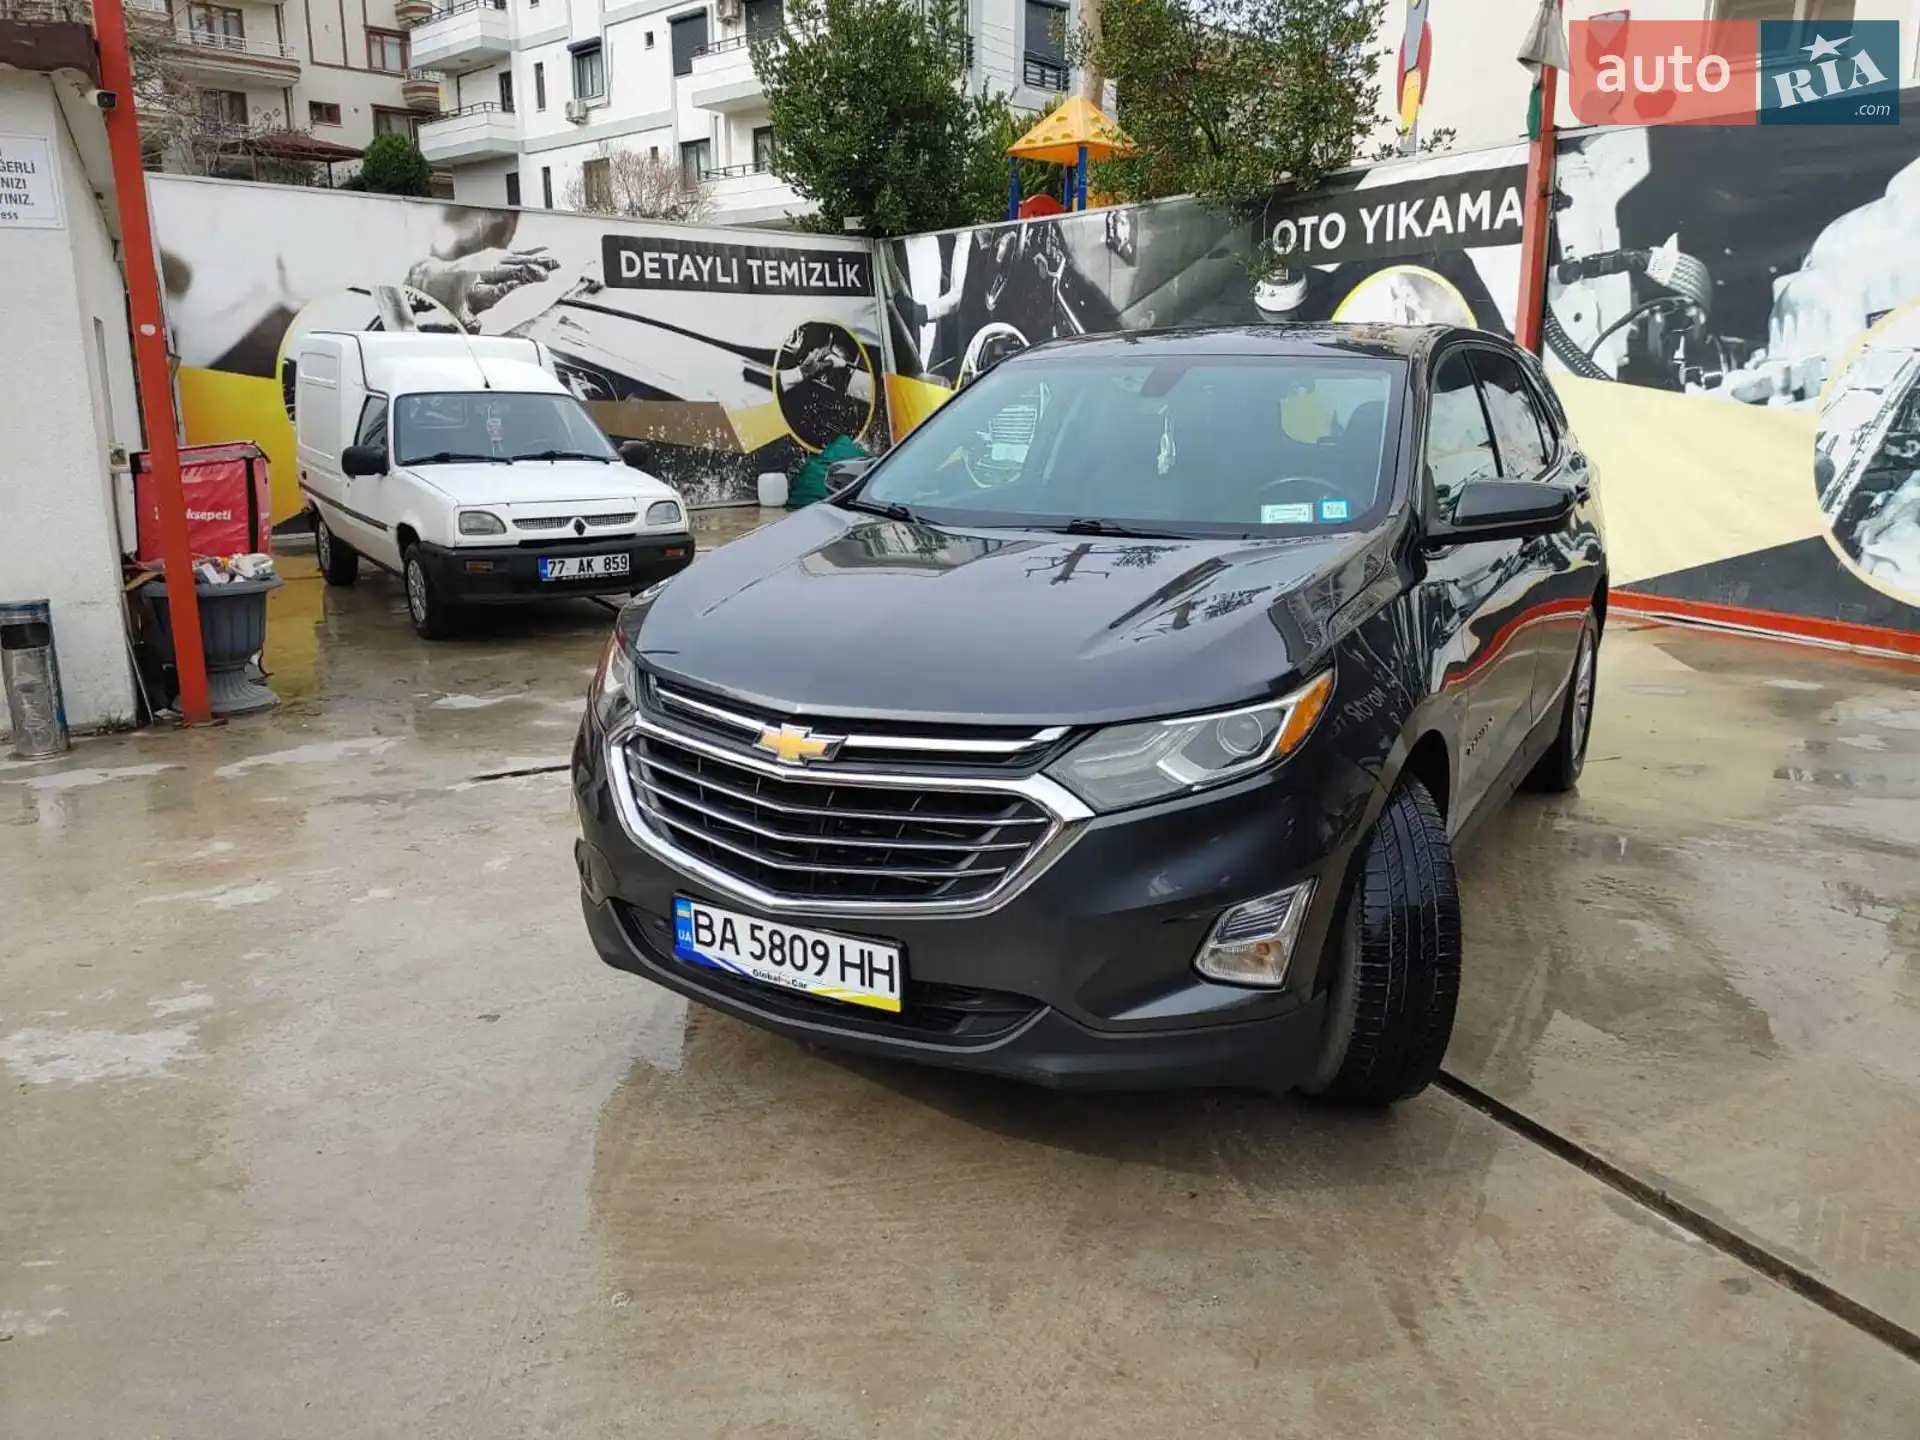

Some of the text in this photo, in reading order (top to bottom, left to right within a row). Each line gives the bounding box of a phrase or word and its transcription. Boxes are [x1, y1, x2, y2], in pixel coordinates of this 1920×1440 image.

[1272, 186, 1524, 256] OTO YIKAMA
[619, 250, 862, 289] DETAYLI TEMİZLİK
[548, 560, 566, 576] 77
[577, 557, 595, 574] AK
[603, 555, 628, 572] 859
[678, 929, 692, 943] UA
[693, 909, 895, 993] BA 5809 HH
